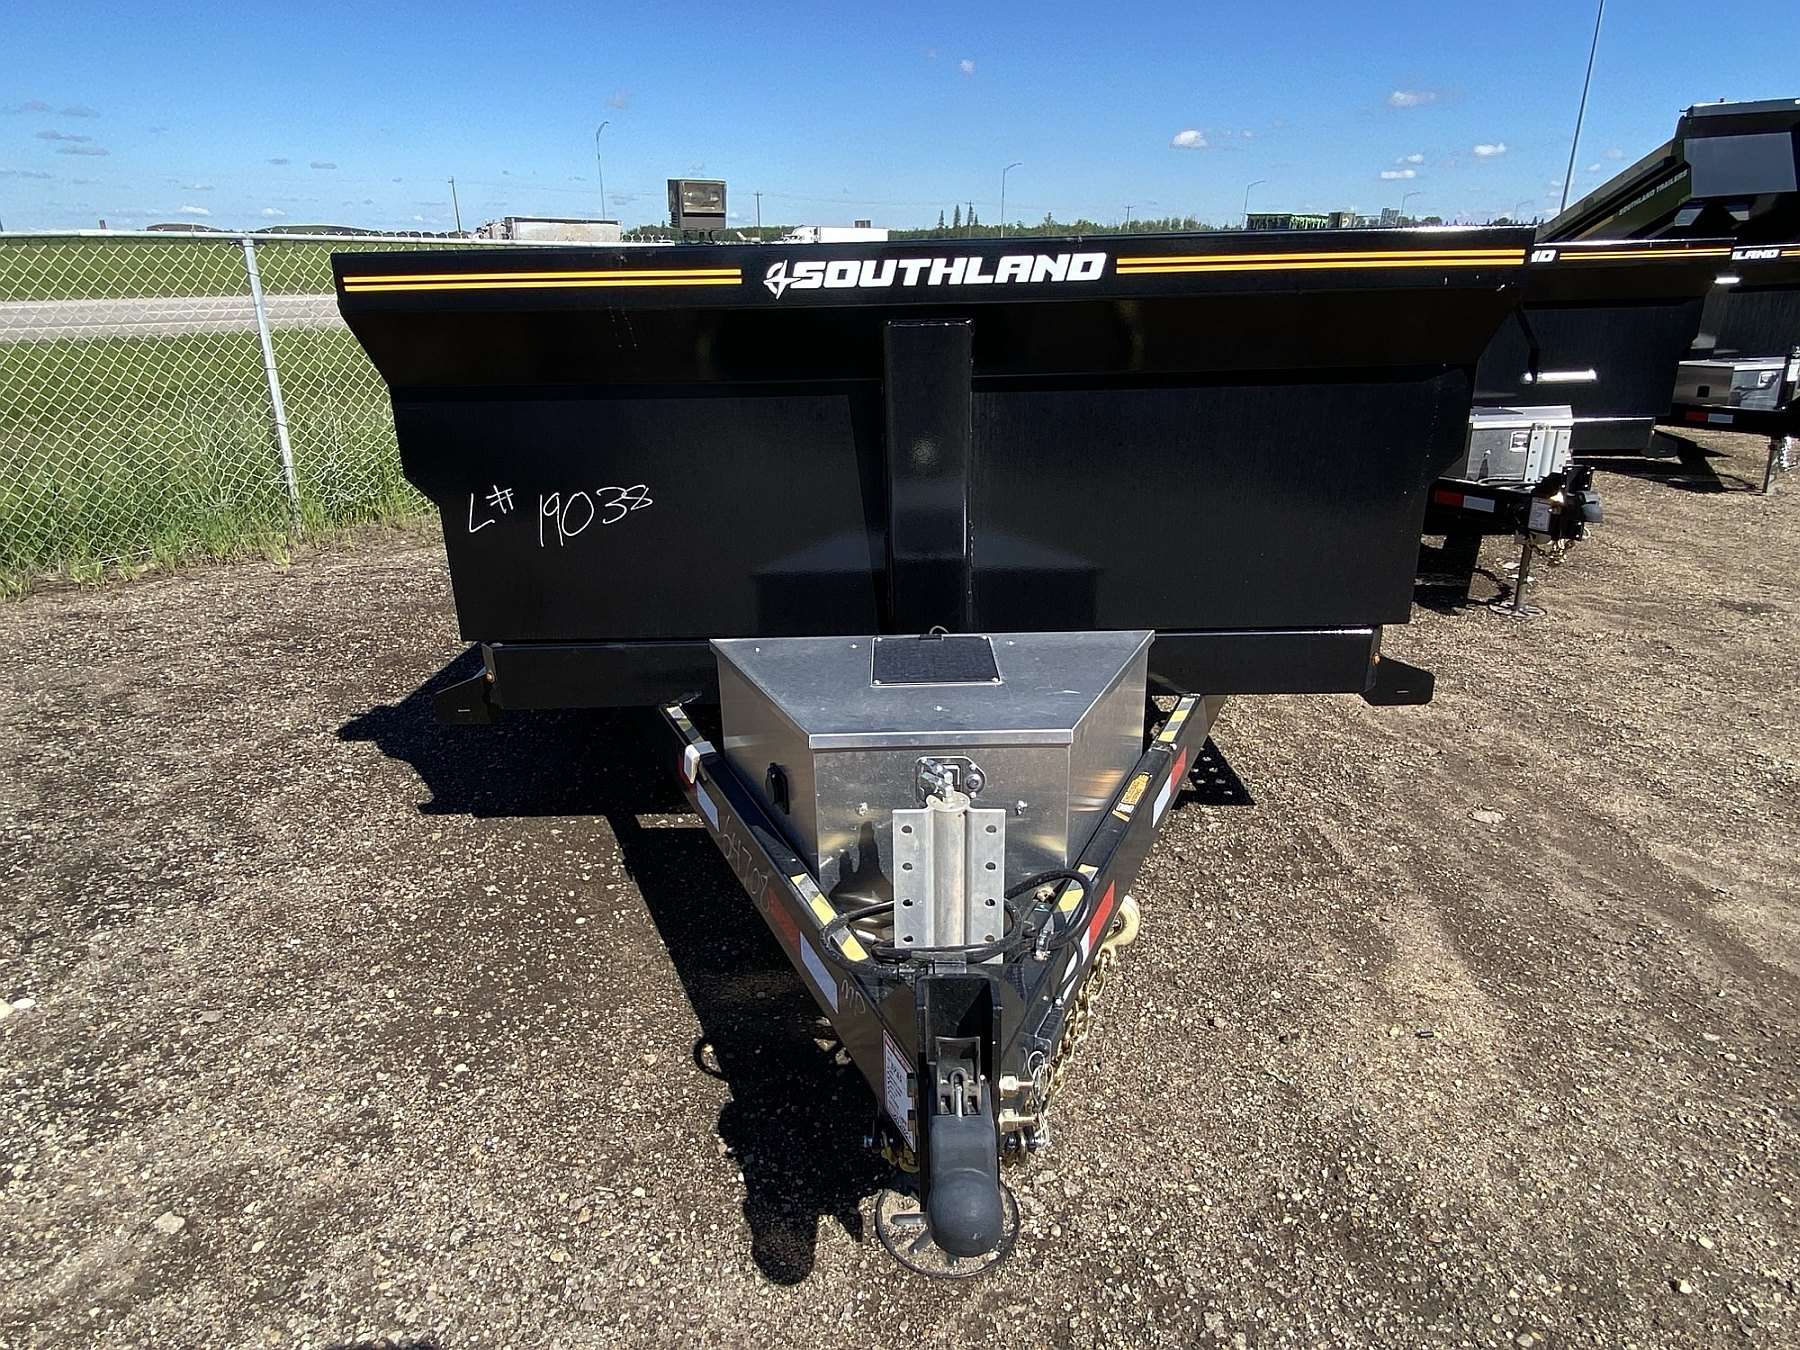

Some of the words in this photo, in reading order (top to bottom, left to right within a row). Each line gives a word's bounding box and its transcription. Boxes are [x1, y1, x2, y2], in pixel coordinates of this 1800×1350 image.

[790, 252, 1107, 289] SOUTHLAND
[1731, 249, 1780, 260] LAND
[468, 484, 515, 533] L#
[538, 484, 654, 547] 19038
